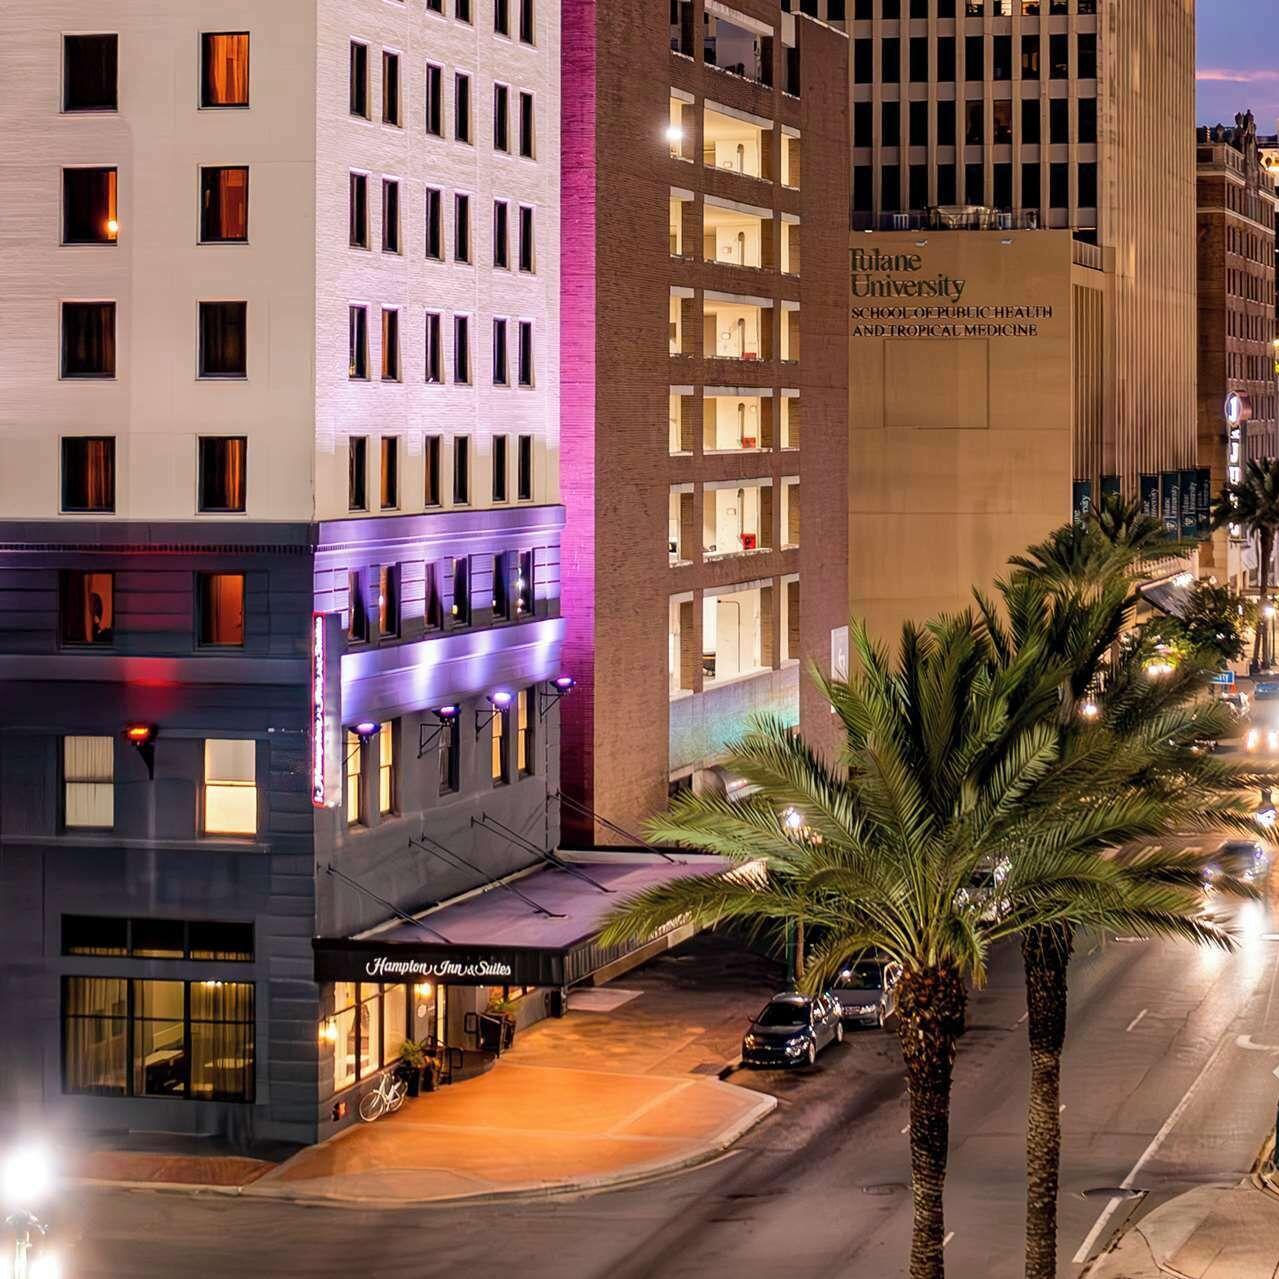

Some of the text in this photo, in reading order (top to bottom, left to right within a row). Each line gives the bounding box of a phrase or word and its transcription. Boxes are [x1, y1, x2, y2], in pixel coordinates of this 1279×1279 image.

[849, 248, 923, 272] Tulane
[851, 273, 966, 304] University
[851, 305, 1053, 320] SCHOOL OF PUBLIC HEALTH
[852, 323, 1039, 337] AND TROPICAL MEDICINE
[366, 957, 433, 976] Hampton
[433, 960, 469, 976] Inn
[474, 960, 511, 976] Suites
